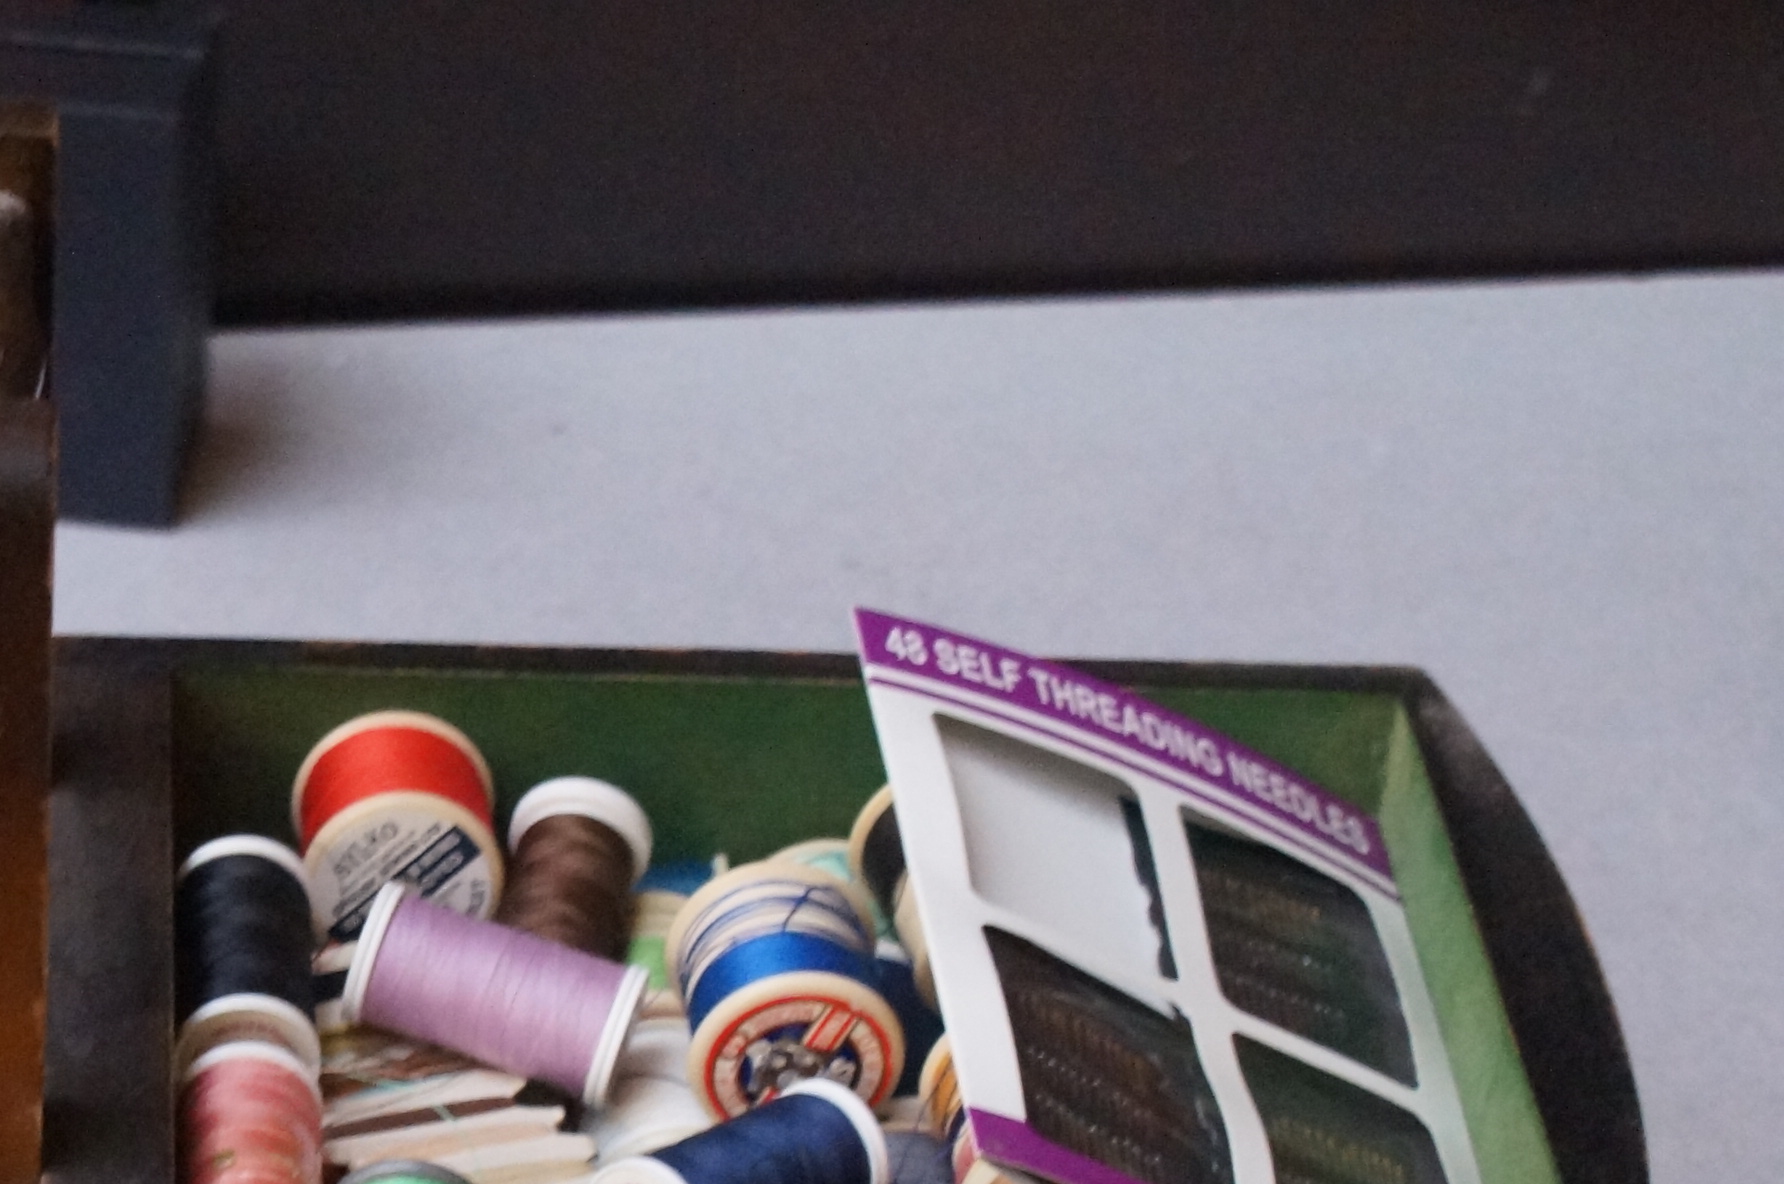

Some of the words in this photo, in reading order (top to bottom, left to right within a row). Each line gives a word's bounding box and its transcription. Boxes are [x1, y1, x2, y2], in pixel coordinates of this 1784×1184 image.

[885, 627, 928, 665] 48
[933, 639, 1021, 692] SELF
[1028, 667, 1223, 776] THREADING
[1226, 751, 1370, 855] NEEDLES
